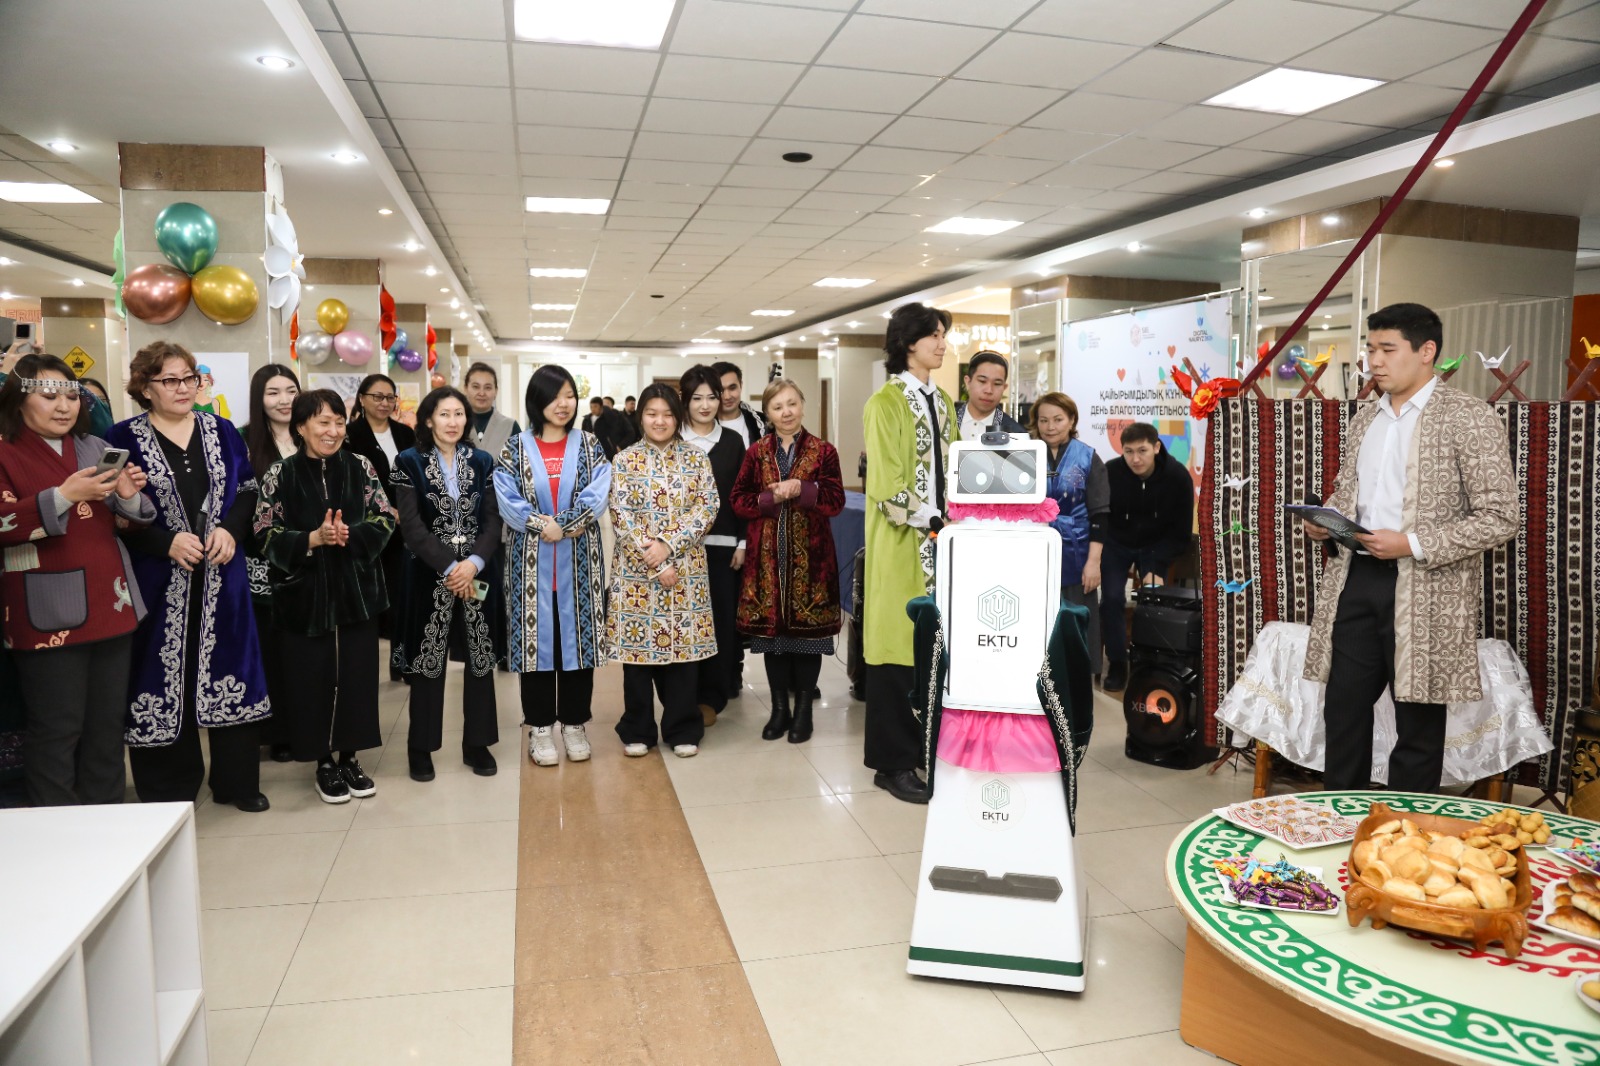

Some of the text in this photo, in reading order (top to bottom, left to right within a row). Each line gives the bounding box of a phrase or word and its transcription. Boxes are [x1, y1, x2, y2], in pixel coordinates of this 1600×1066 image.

[1100, 388, 1164, 401] ҚАЙЫРЫМДЫЛЫҚ
[1091, 405, 1108, 416] ДЕНЬ
[978, 634, 1018, 648] EKTU
[982, 811, 1009, 822] EKTU
